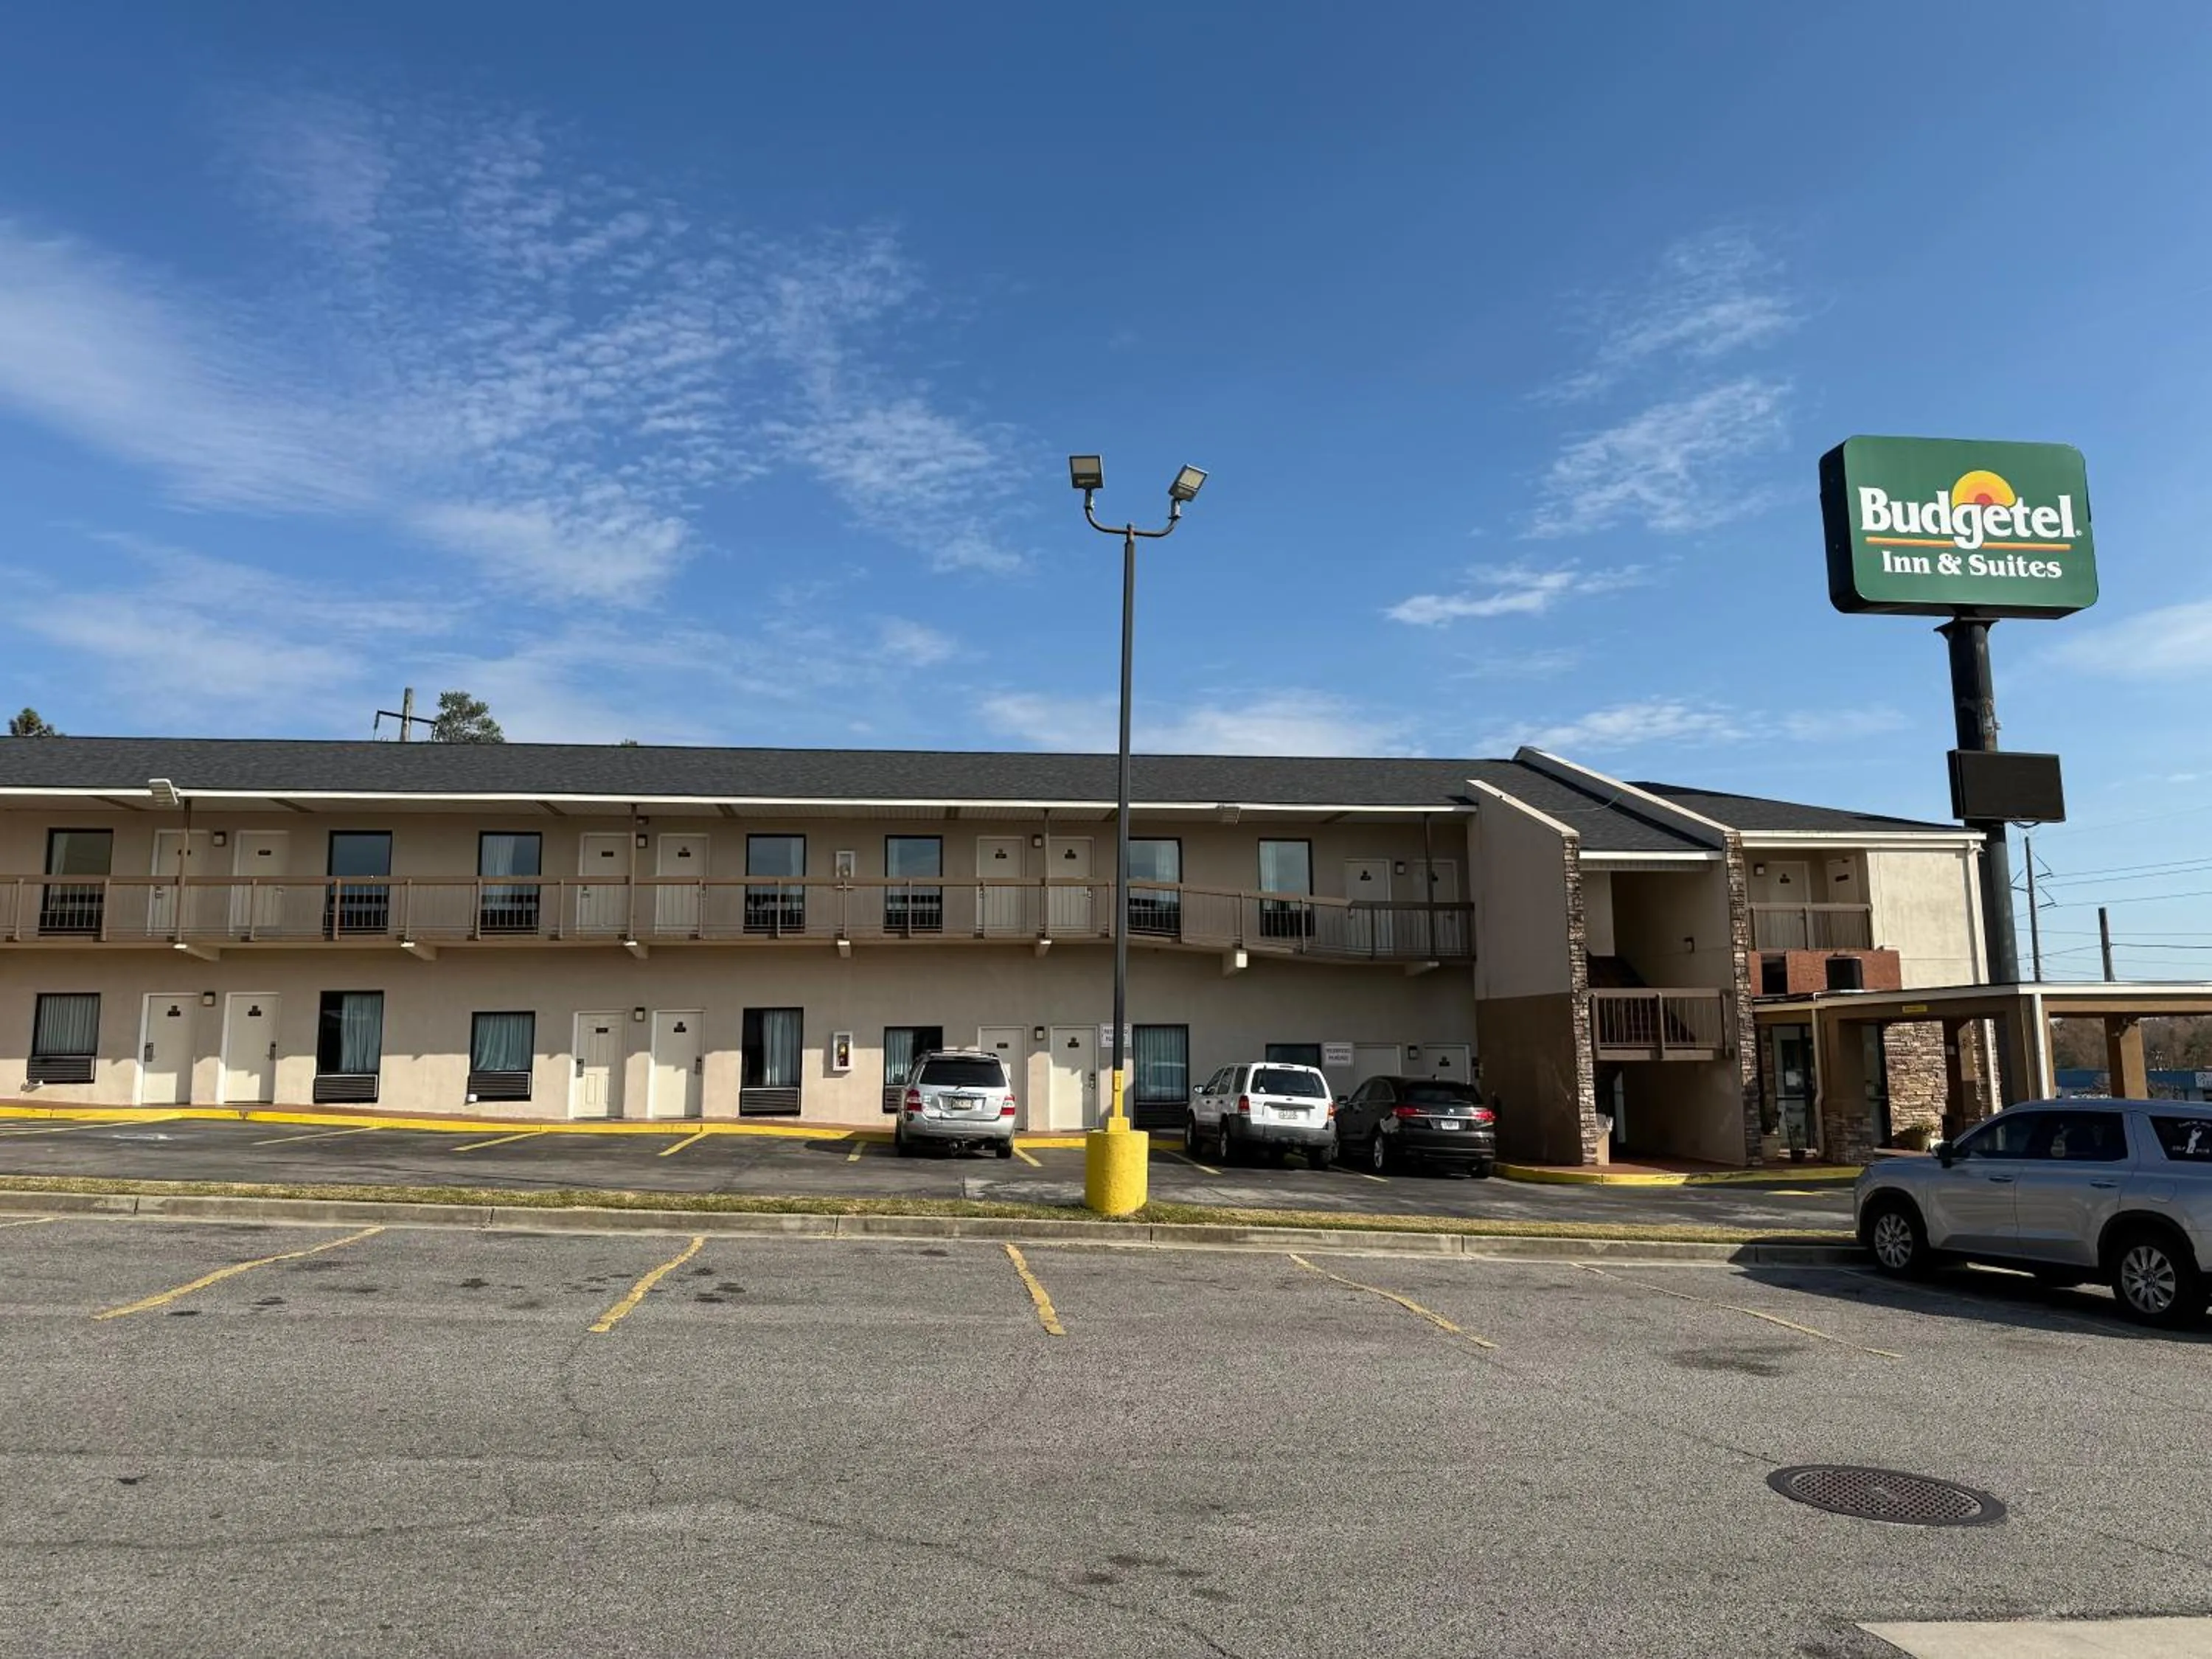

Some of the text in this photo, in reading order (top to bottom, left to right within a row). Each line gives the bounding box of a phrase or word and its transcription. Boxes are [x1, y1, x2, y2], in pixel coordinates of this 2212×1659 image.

[1858, 487, 2076, 549] Budgetel
[1882, 550, 2062, 578] Inn & Suites
